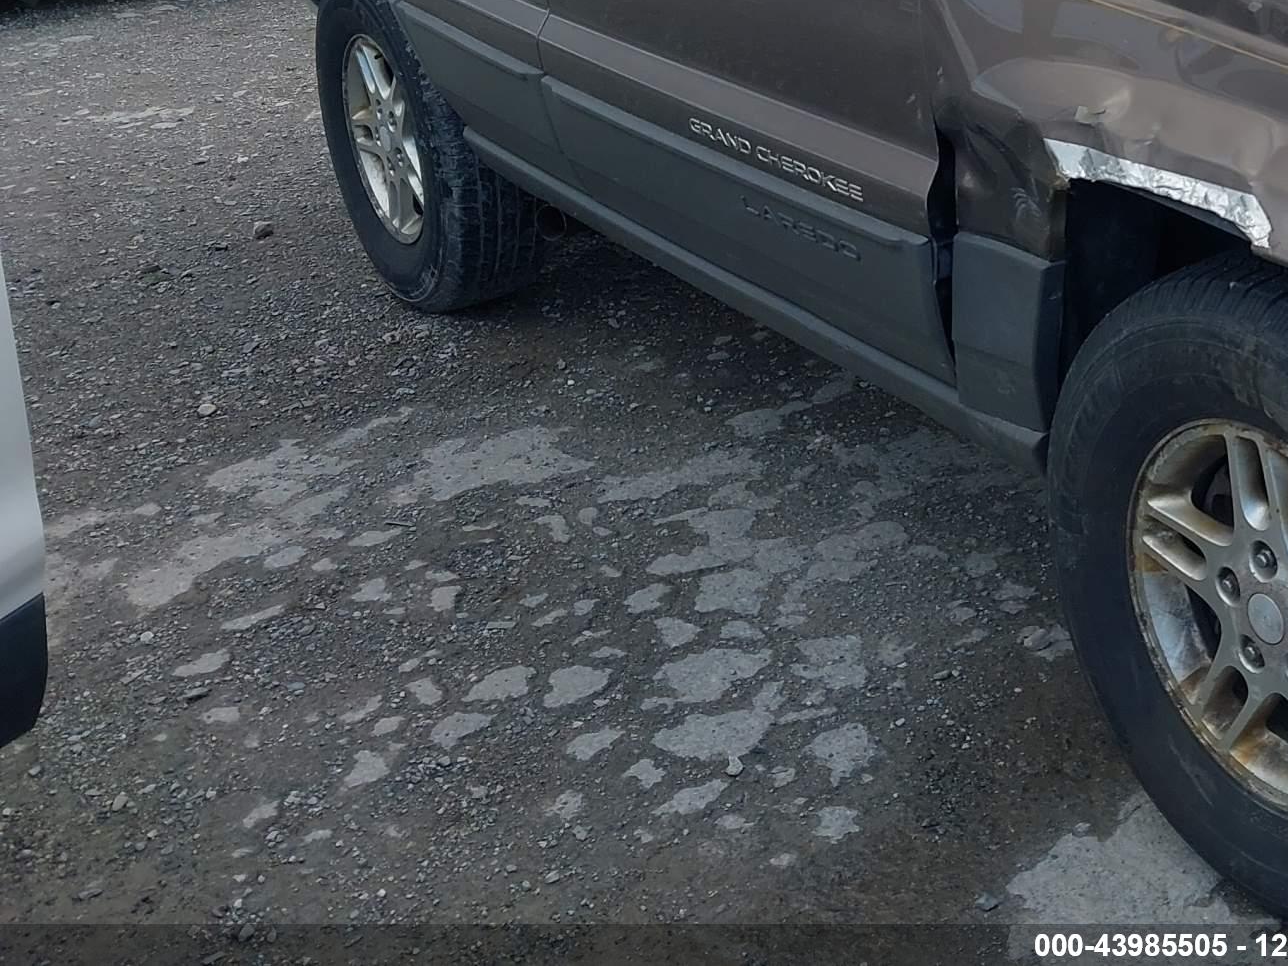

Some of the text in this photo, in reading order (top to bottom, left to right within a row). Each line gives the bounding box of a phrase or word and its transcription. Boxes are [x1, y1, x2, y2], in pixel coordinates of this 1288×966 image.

[688, 116, 864, 203] GRAND CHEROKEE
[740, 194, 862, 262] LAREDO
